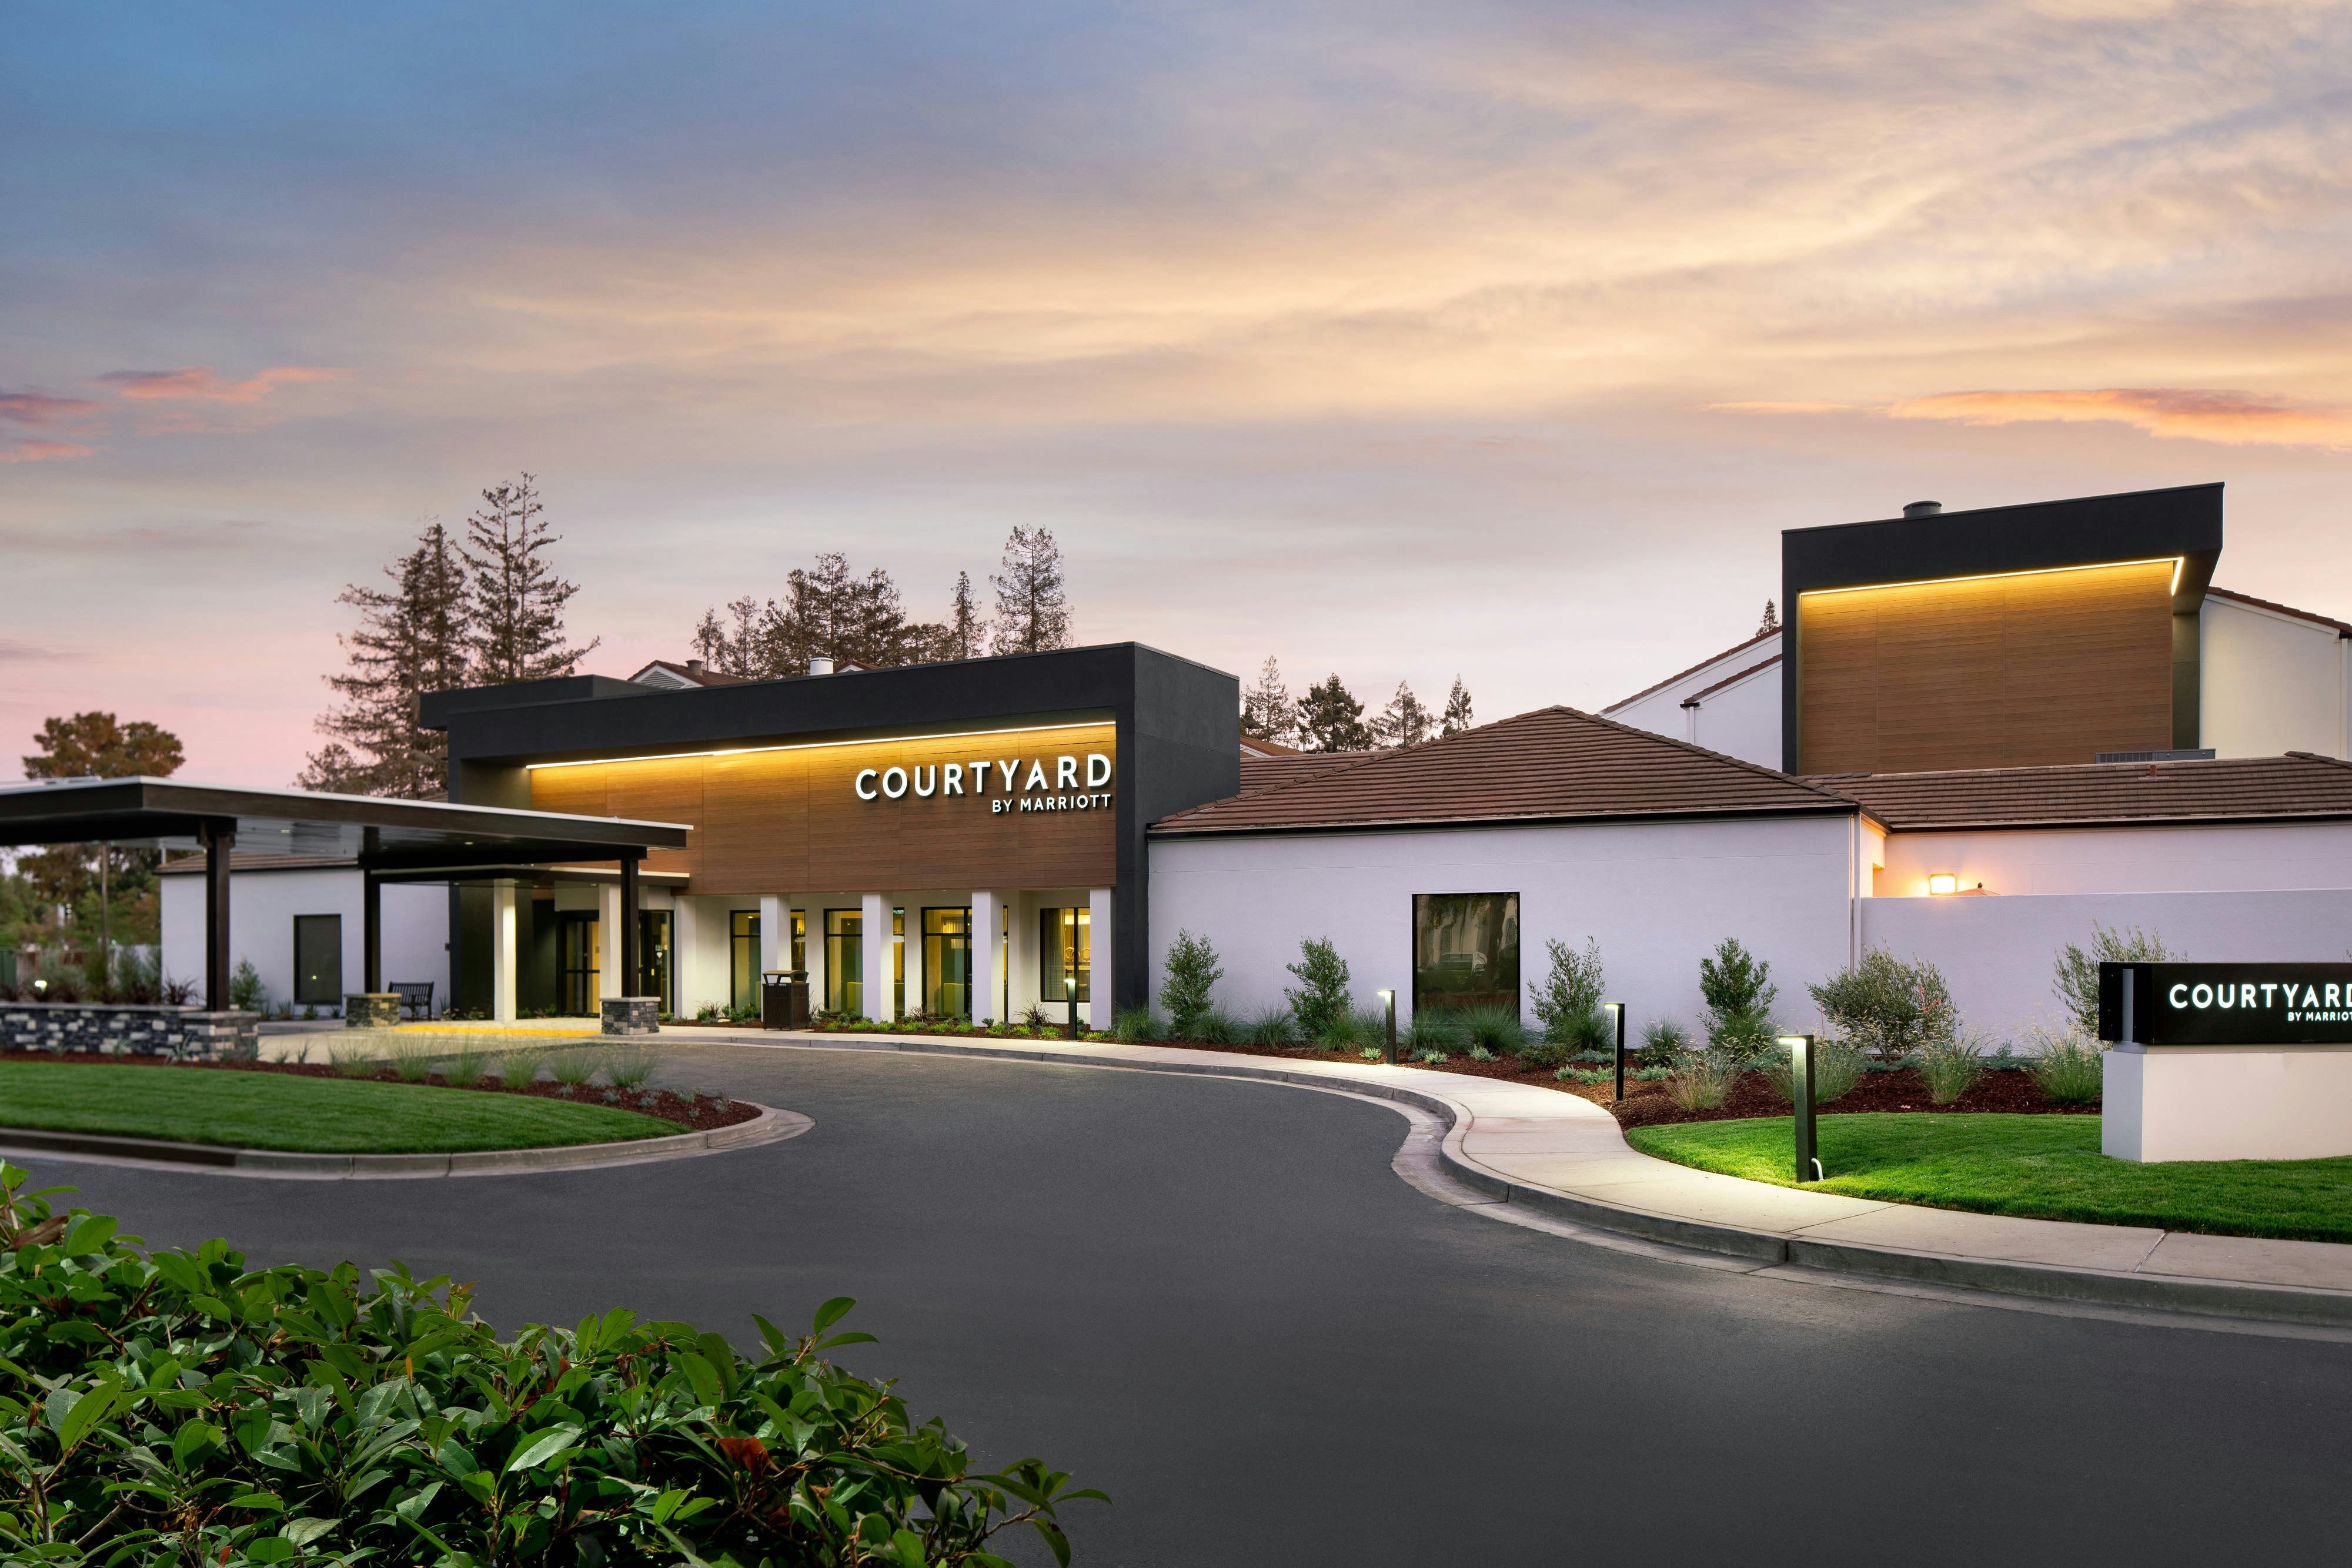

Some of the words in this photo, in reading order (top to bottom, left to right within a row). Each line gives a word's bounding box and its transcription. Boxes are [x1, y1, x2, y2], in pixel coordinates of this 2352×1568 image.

[856, 754, 1112, 800] COURTYARD
[992, 799, 1013, 813] BY
[1020, 794, 1111, 811] MARRIOTT
[2288, 1012, 2302, 1021] BY
